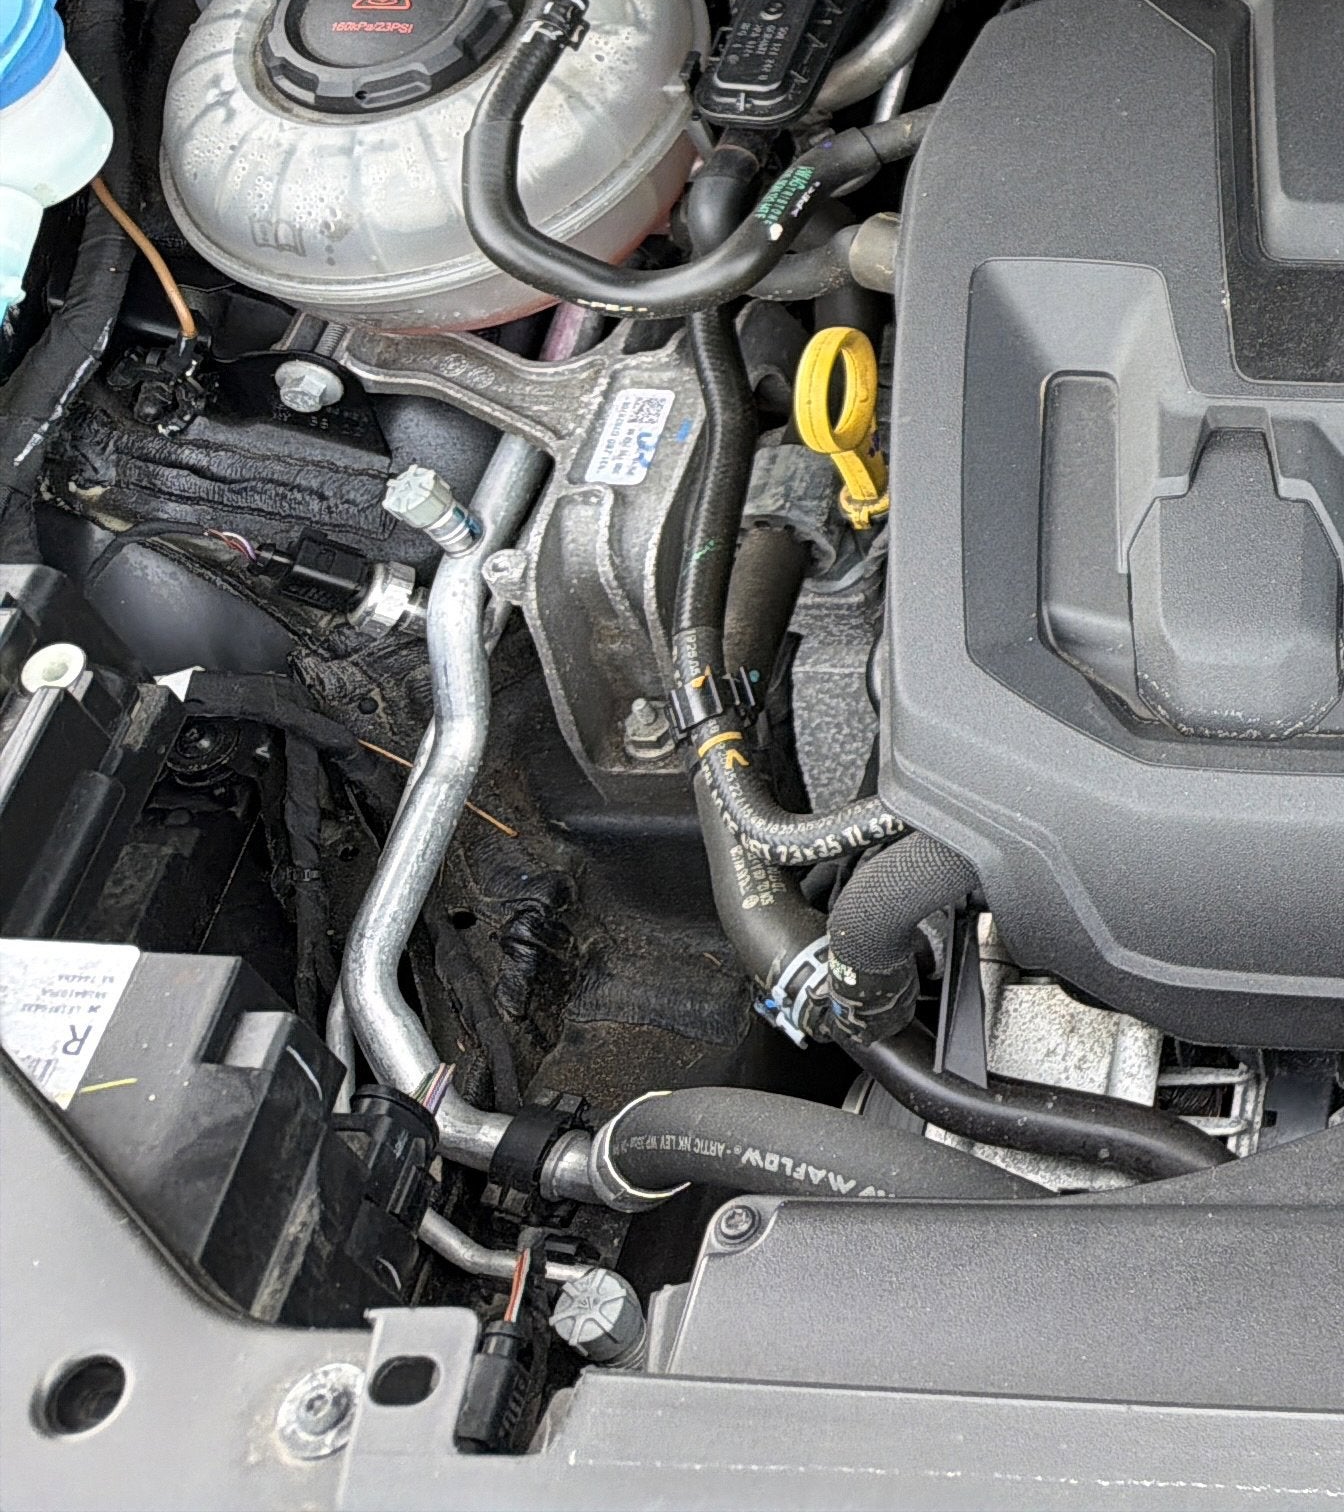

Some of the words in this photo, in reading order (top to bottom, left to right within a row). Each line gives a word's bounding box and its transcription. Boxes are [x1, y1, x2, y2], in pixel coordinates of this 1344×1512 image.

[61, 1025, 93, 1056] R
[692, 1137, 726, 1157] ARTIC
[740, 1148, 856, 1194] MAFLOW
